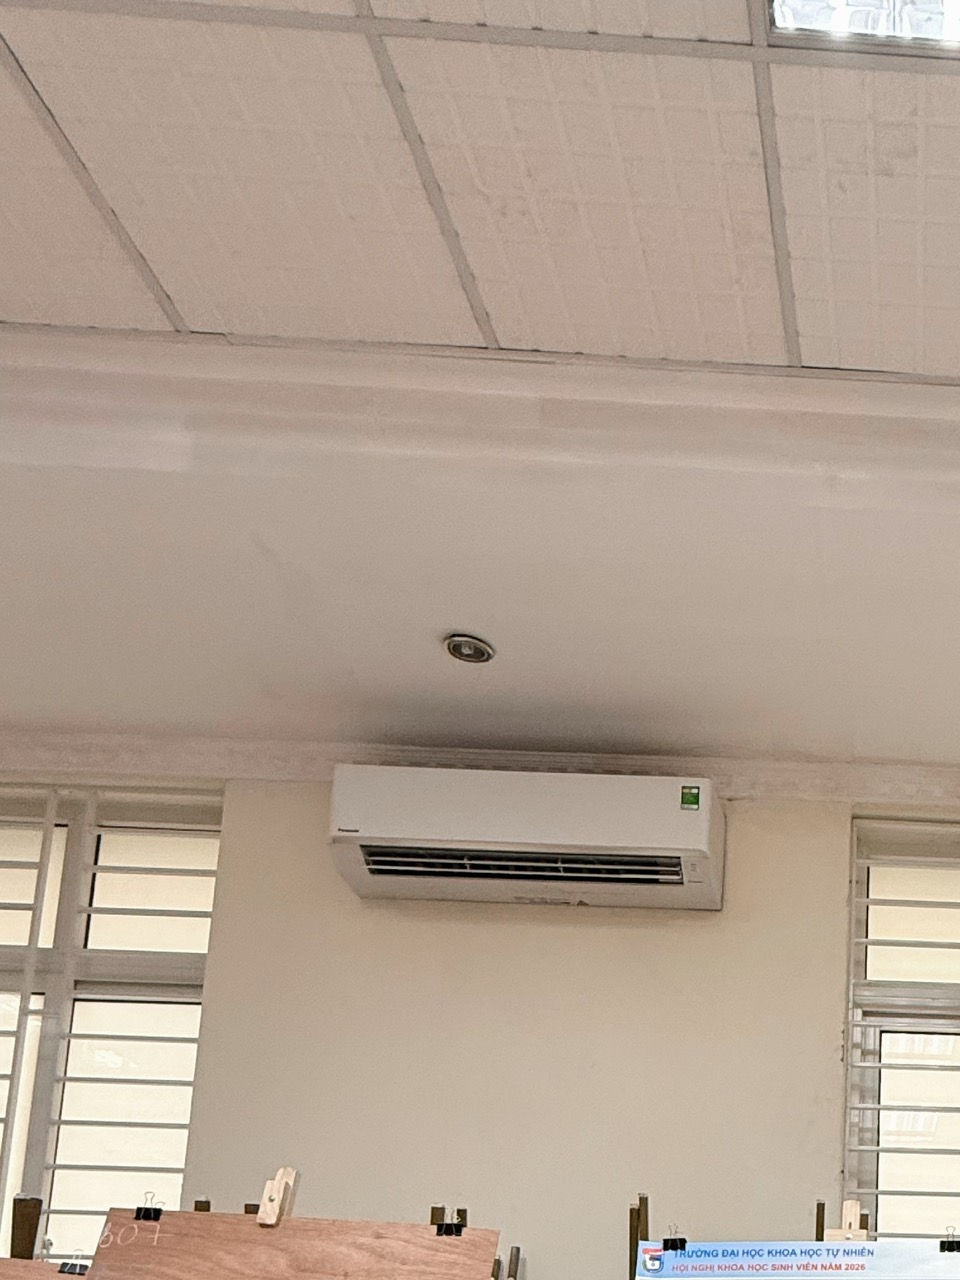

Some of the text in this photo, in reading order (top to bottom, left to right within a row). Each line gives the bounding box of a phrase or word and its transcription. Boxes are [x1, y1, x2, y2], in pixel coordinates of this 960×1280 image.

[674, 1246, 874, 1260] TRƯỜNG ĐẠI HỌC KHOA HỌC TỰ NHIÊN
[672, 1261, 866, 1273] HỘI NGHỊ KHOA HỌC SINH VIÊN NĂM 2026
